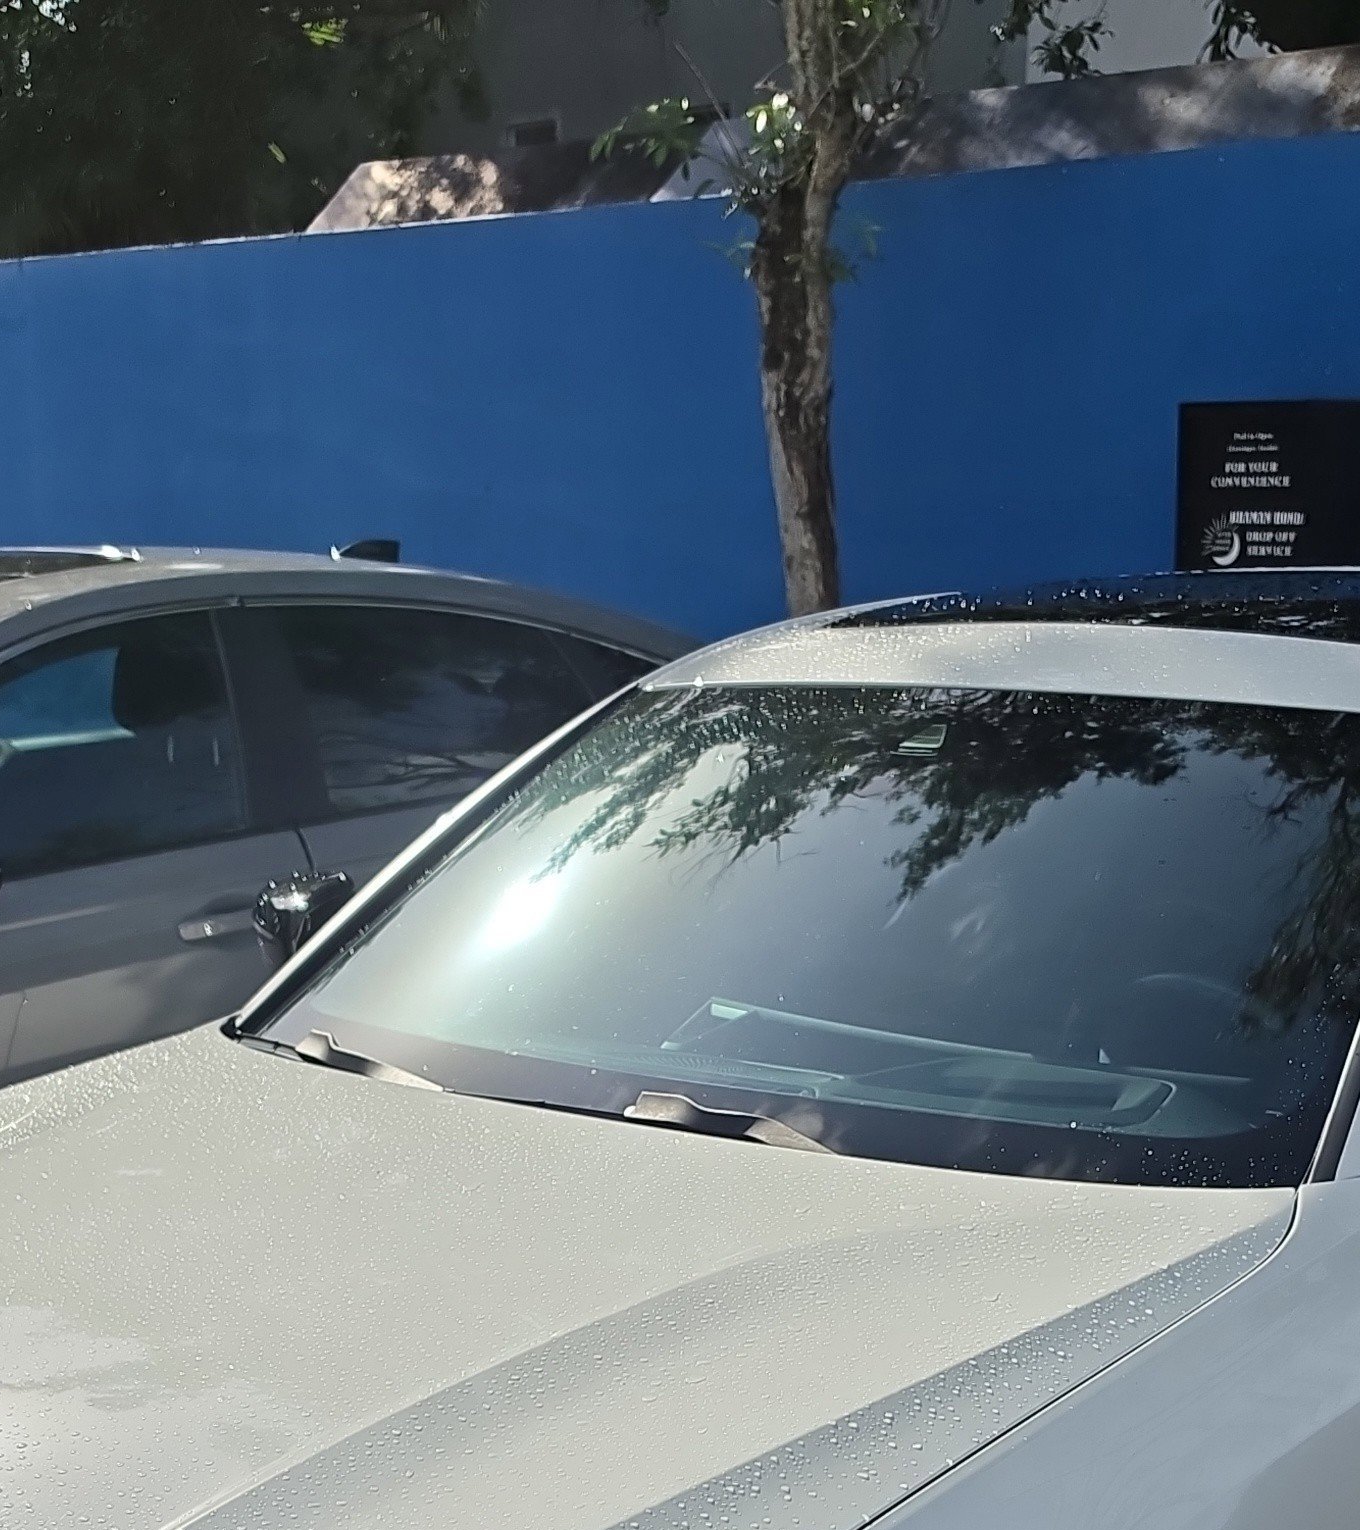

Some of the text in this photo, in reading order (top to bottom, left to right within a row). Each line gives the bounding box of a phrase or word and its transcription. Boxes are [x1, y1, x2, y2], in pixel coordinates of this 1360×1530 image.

[1224, 461, 1279, 473] FOR YOUR
[1210, 475, 1291, 488] CONVENIENCE
[1245, 531, 1274, 543] DROP
[1274, 531, 1297, 543] OFF
[1246, 545, 1293, 557] SERVICE
